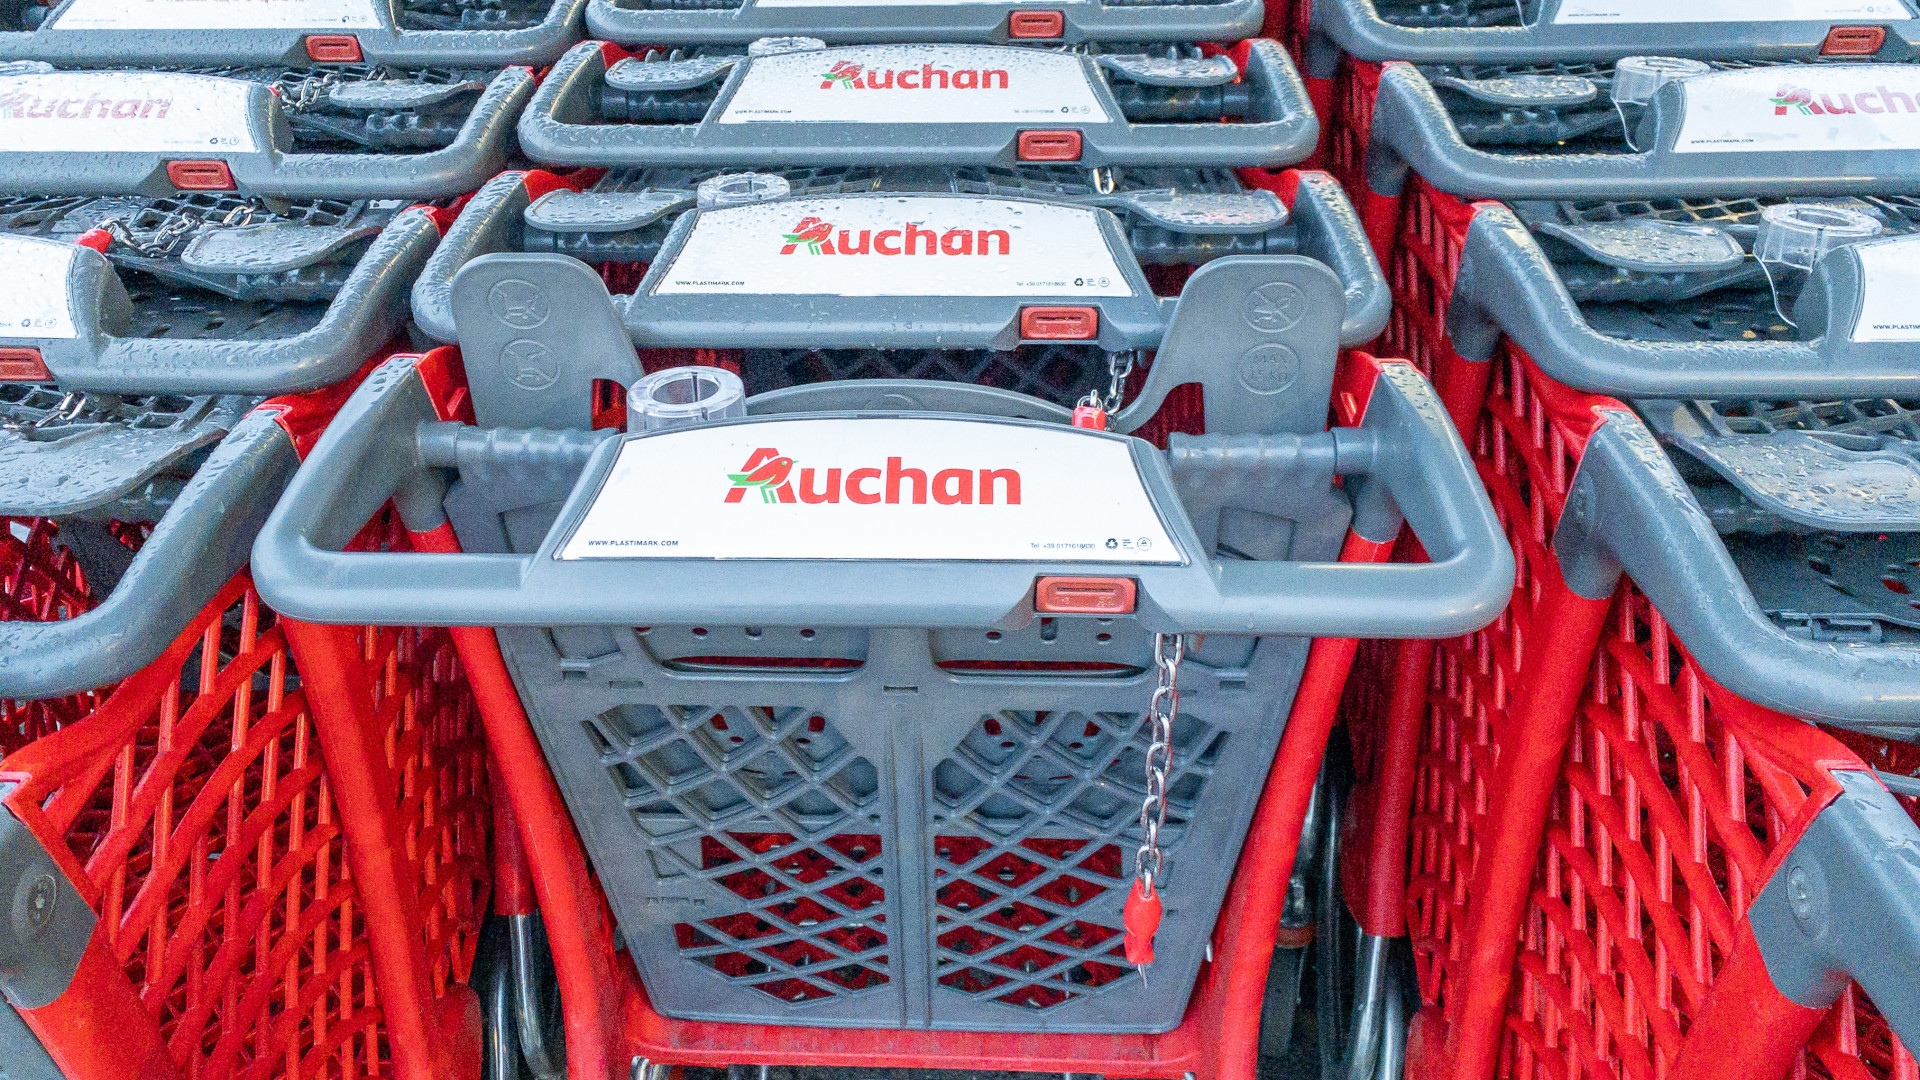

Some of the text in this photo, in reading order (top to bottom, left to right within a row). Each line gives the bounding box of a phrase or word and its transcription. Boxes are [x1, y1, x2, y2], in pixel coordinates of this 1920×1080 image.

[820, 60, 1008, 89] Auchan
[1769, 84, 1920, 116] Auch
[780, 216, 1010, 256] Auchan
[724, 447, 1021, 505] Auchan
